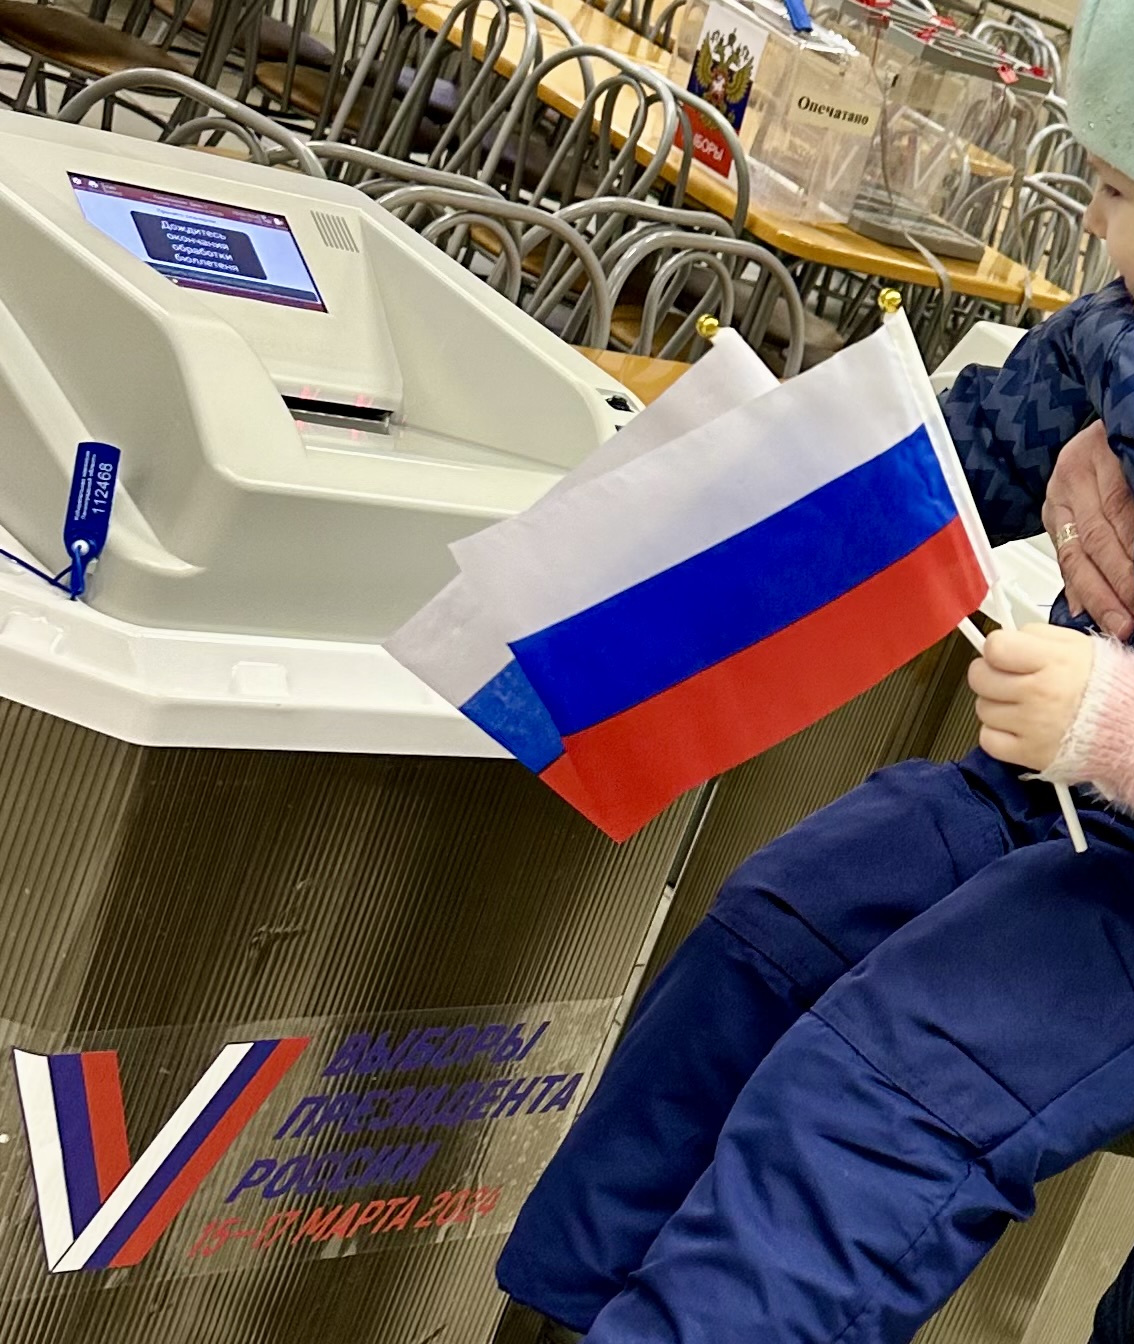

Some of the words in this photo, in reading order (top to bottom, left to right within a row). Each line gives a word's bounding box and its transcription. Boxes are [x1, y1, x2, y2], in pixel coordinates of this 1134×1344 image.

[797, 95, 870, 126] Опечатано
[691, 132, 725, 161] БОРЫ
[160, 220, 227, 241] Дождитесь
[166, 232, 230, 252] окончания
[172, 242, 234, 262] обработки
[174, 253, 240, 273] бюллетеня
[91, 462, 113, 514] 112468
[321, 1020, 552, 1077] ВЫБОРЫ
[273, 1072, 584, 1141] ПРЕЗИДЕНТА
[224, 1140, 442, 1204] РОССИИ
[291, 1194, 422, 1246] МАРТА
[413, 1184, 502, 1229] 2024
